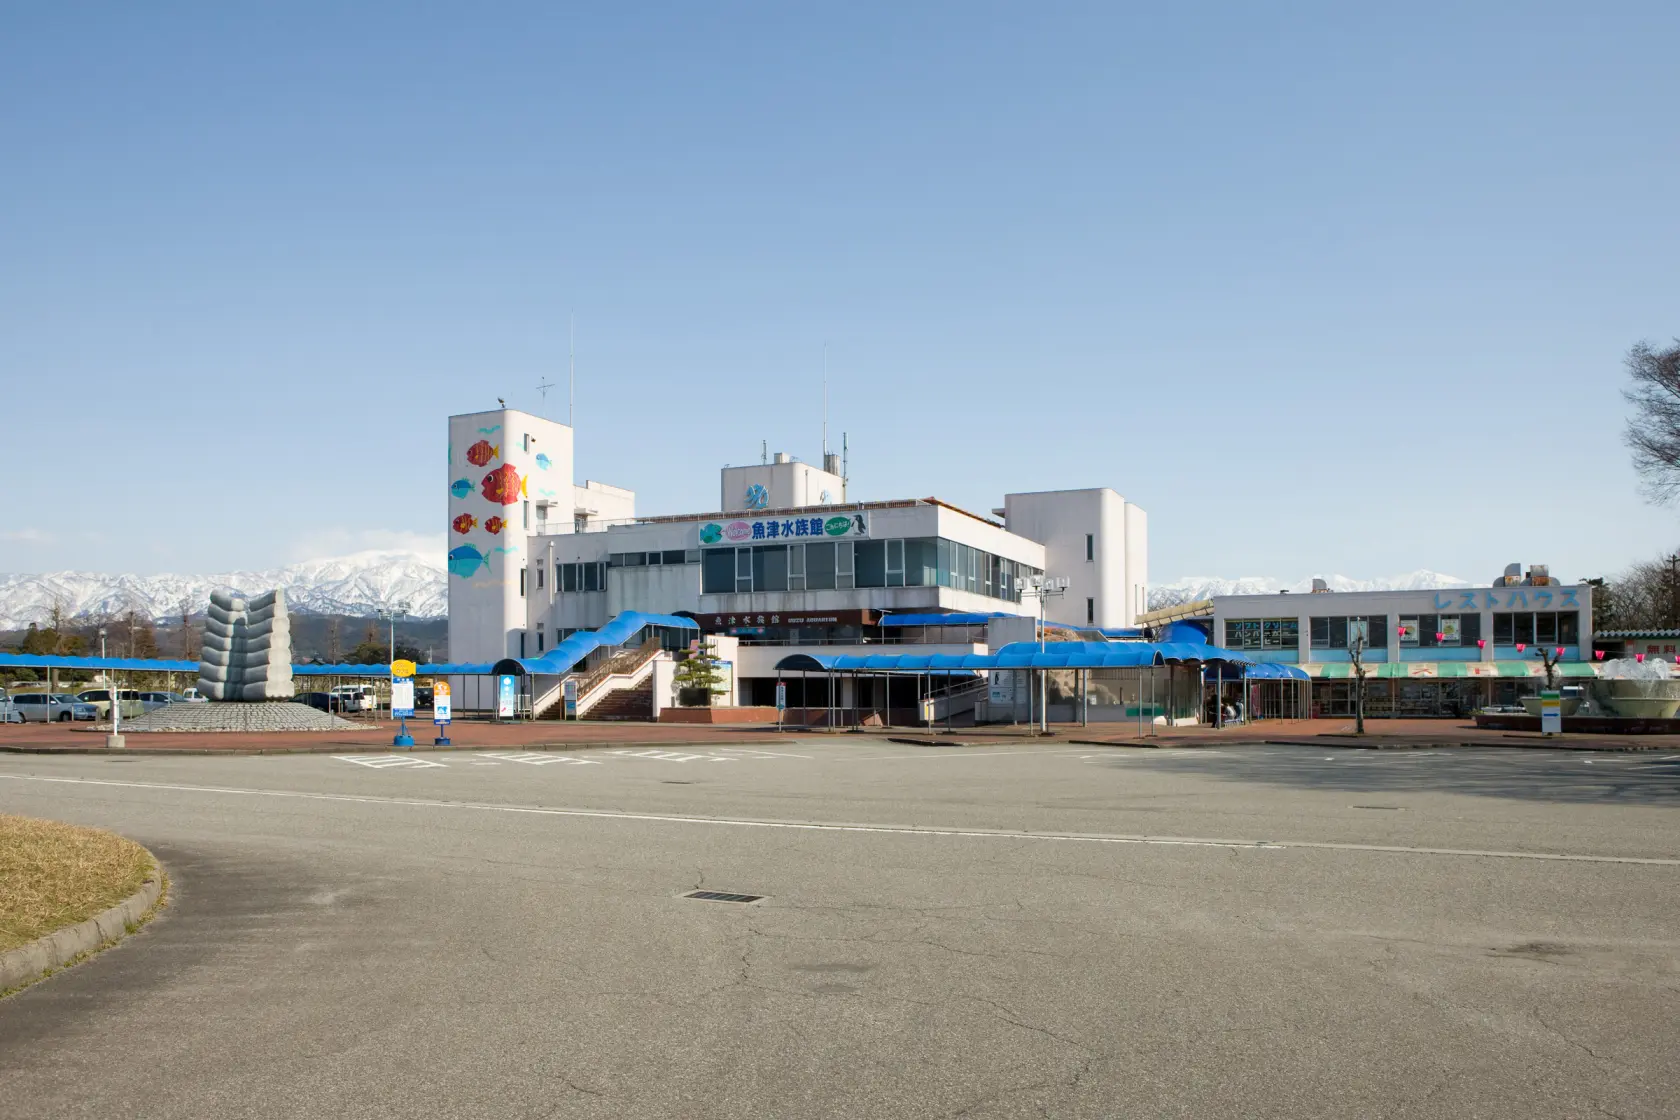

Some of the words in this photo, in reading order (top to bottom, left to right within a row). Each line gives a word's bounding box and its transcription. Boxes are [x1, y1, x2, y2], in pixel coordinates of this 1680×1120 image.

[752, 517, 824, 539] 魚津水族館
[1434, 590, 1580, 609] レストハウス
[715, 615, 779, 625] 魚津水族館
[1235, 622, 1297, 630] ソフトクリーム
